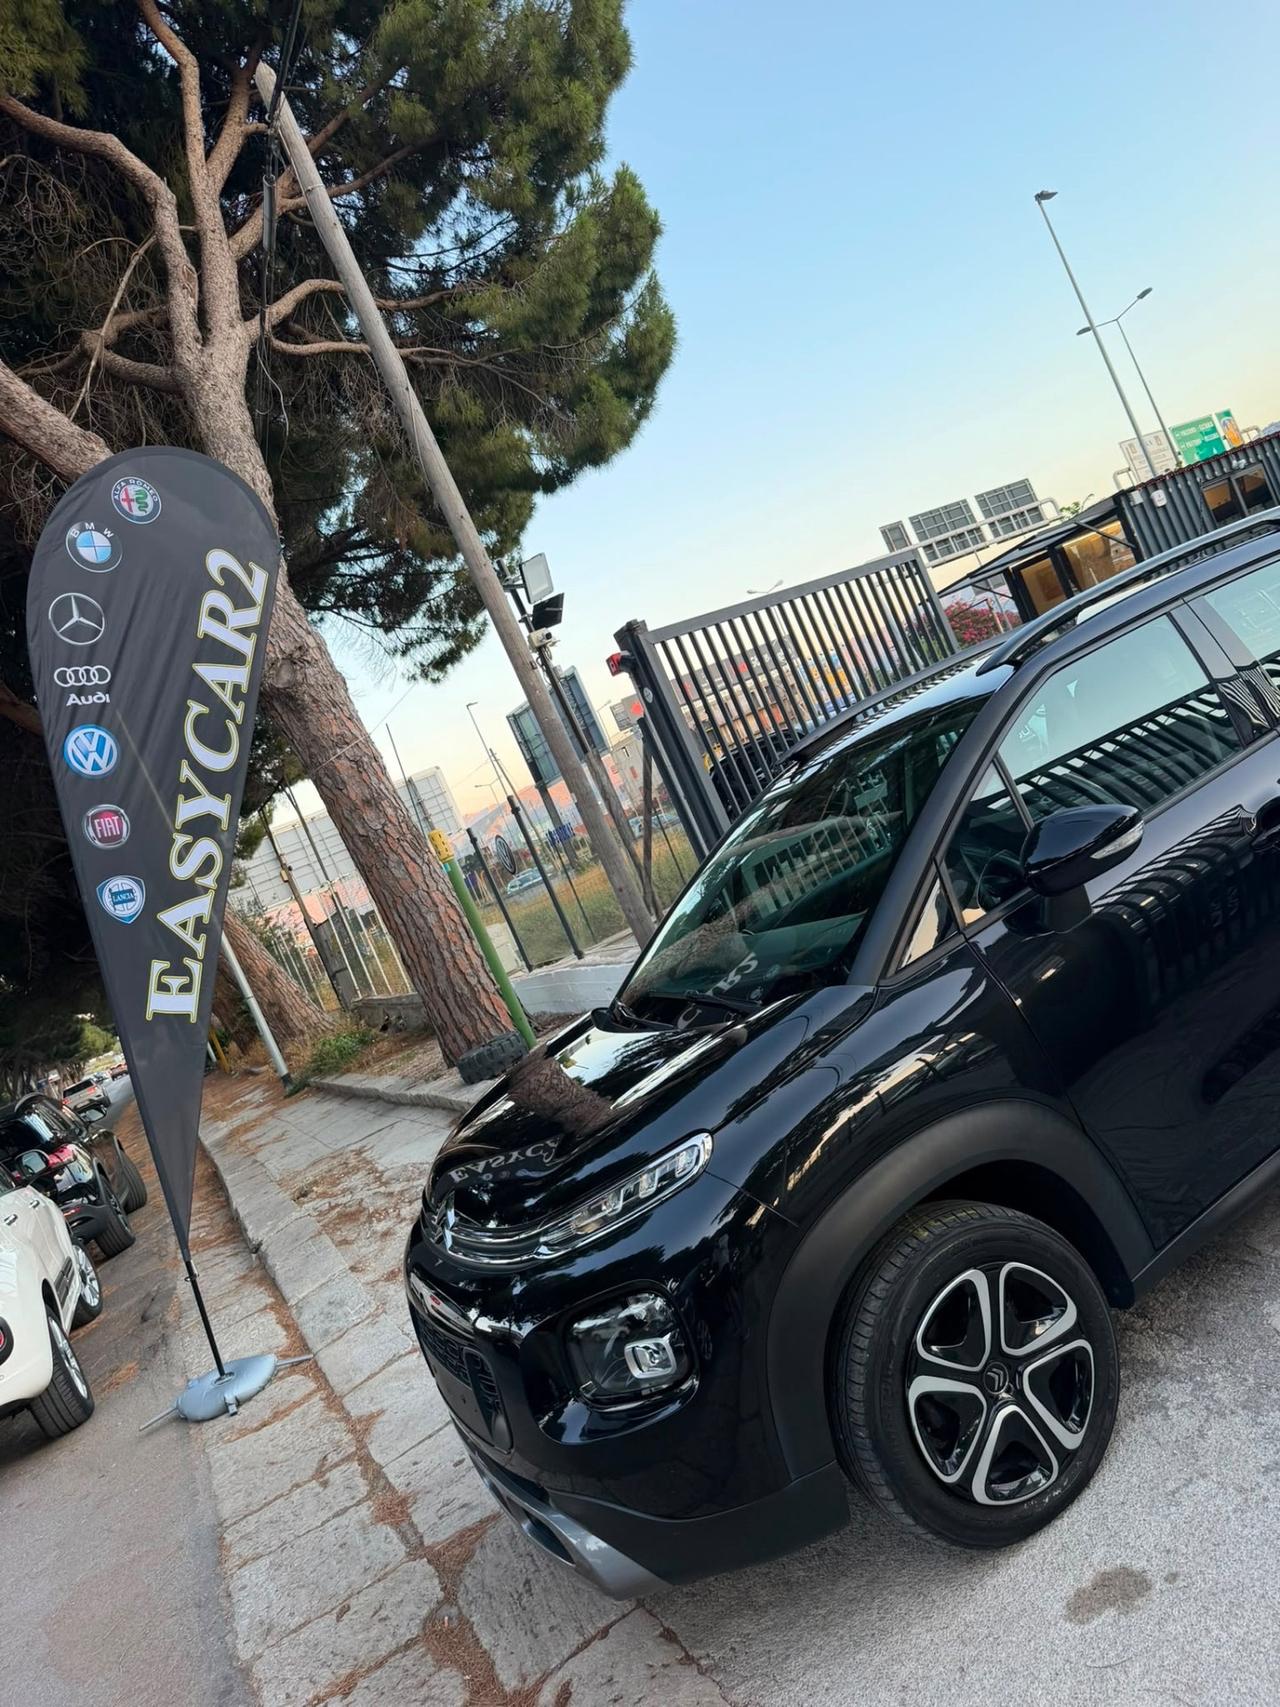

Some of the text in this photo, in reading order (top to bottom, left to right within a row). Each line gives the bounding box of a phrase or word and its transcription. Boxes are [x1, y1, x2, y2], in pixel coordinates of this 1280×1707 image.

[129, 479, 158, 501] ROMEO
[70, 522, 114, 538] BMW
[66, 691, 110, 706] Audi
[146, 548, 269, 1023] EASYCAR2
[94, 816, 120, 838] FIAT
